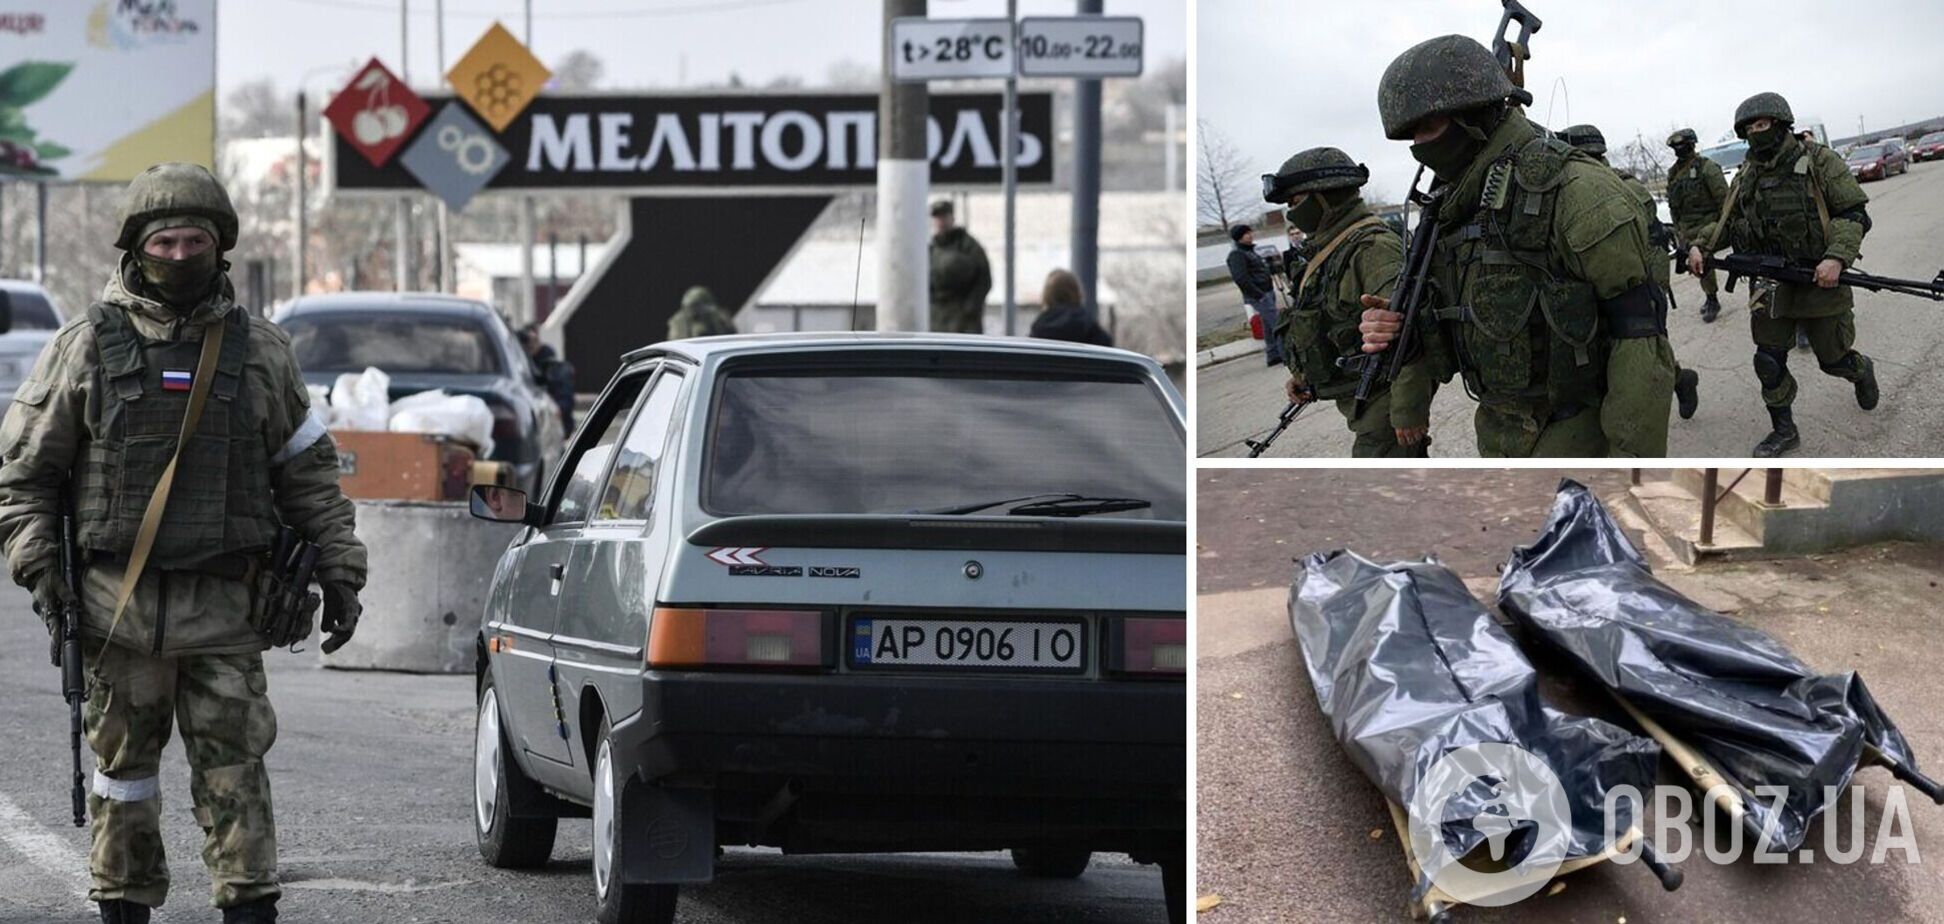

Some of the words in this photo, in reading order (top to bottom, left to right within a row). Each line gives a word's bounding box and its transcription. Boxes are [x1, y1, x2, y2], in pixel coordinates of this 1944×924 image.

[525, 109, 1043, 172] МЕЛІТОПЛЬ
[731, 566, 802, 576] AVRIA
[809, 567, 860, 578] NOVA
[855, 648, 871, 658] UA
[875, 625, 925, 661] AP
[935, 627, 1015, 661] 0906
